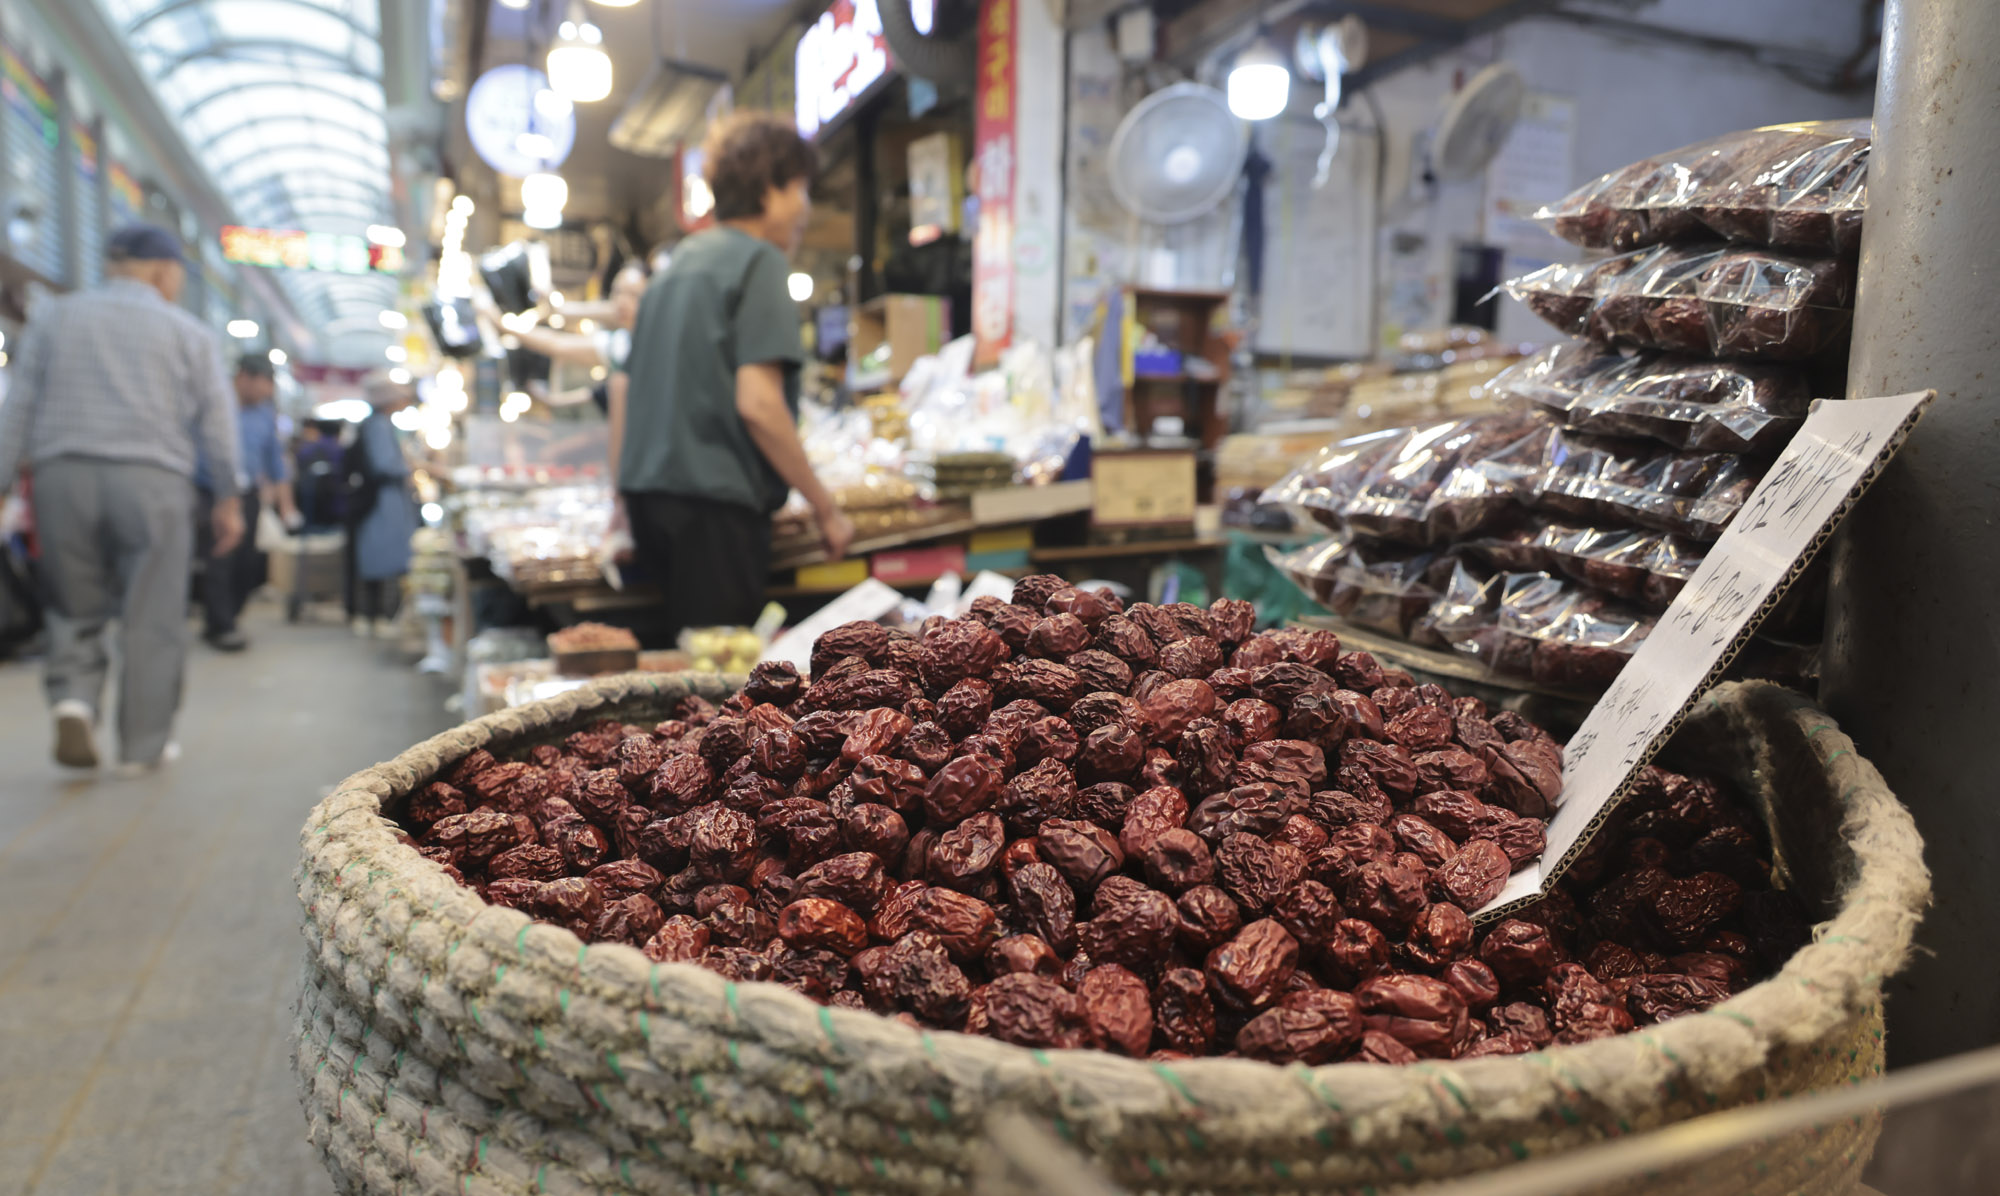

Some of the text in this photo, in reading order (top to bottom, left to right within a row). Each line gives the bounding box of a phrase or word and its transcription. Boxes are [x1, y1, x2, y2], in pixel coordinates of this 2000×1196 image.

[1739, 430, 1872, 538] 경산 대추
[1617, 711, 1669, 768] 국산
